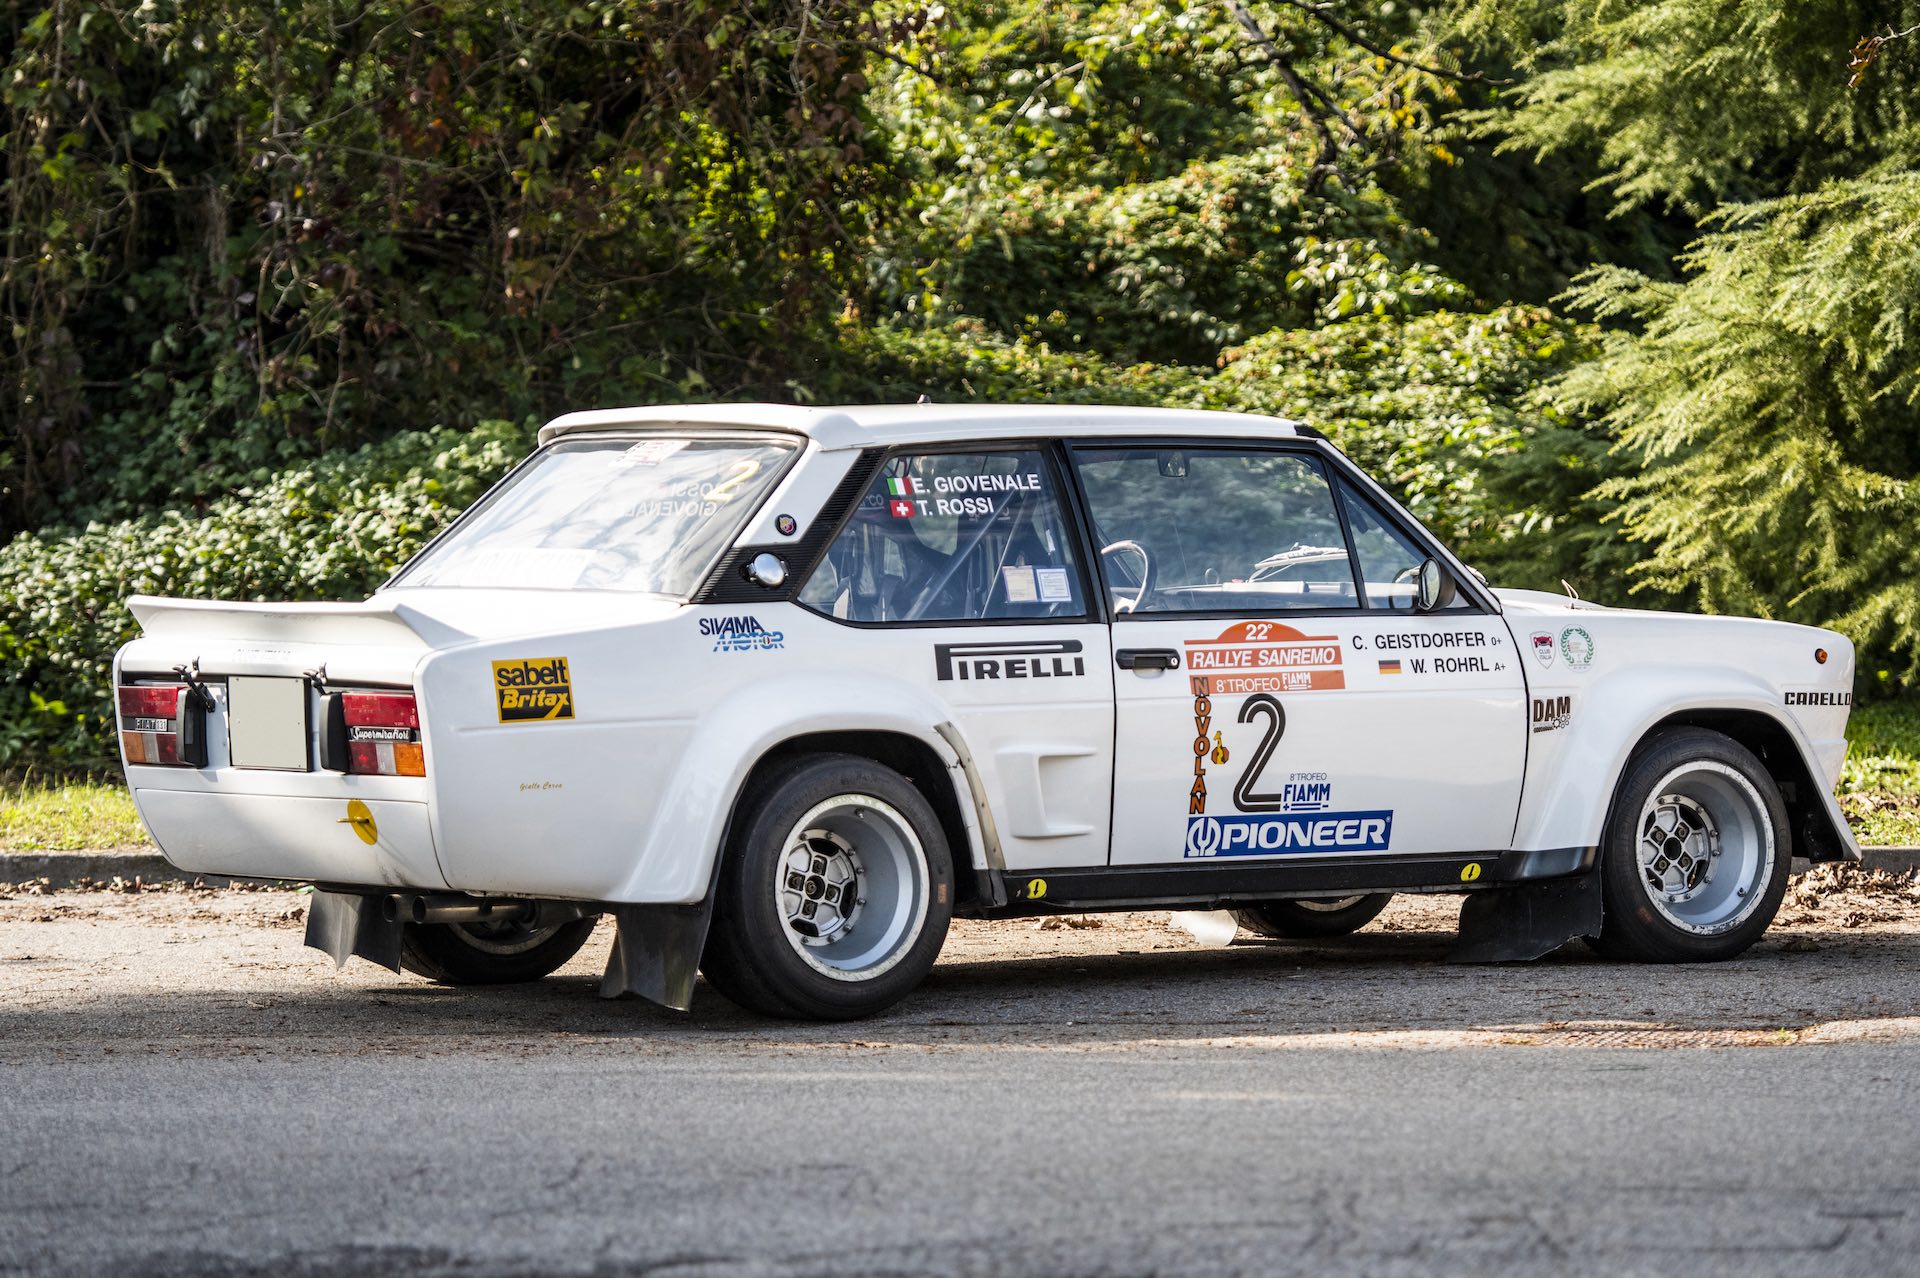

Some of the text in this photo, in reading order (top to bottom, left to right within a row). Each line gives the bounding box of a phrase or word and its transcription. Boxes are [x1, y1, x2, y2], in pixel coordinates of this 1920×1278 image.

[703, 458, 761, 502] 2
[912, 474, 1042, 494] E. GIOVENALE
[916, 498, 933, 517] T.
[937, 497, 995, 516] ROSSI
[699, 615, 766, 636] SIVAMA
[713, 630, 785, 653] MOTOR
[1352, 635, 1368, 650] C.
[1375, 632, 1486, 650] GEISTDORFER
[934, 639, 1085, 681] PIRELLI
[1192, 647, 1336, 668] RALLYE SANREMO
[1410, 658, 1427, 674] W.
[1434, 657, 1490, 673] ROHRL
[496, 659, 568, 687] sabelt
[1228, 677, 1281, 692] TROFEO
[1281, 672, 1312, 685] FIAMM
[501, 689, 570, 719] Britax
[1533, 696, 1571, 722] DAM
[1784, 692, 1851, 706] CARELLO
[352, 727, 409, 740] Supermirafiori
[1189, 676, 1212, 815] NOVOLAN
[1232, 692, 1287, 813] 2
[1297, 772, 1328, 781] TROFEO
[1283, 783, 1332, 802] FIAMM
[1221, 818, 1387, 851] PIONEER
